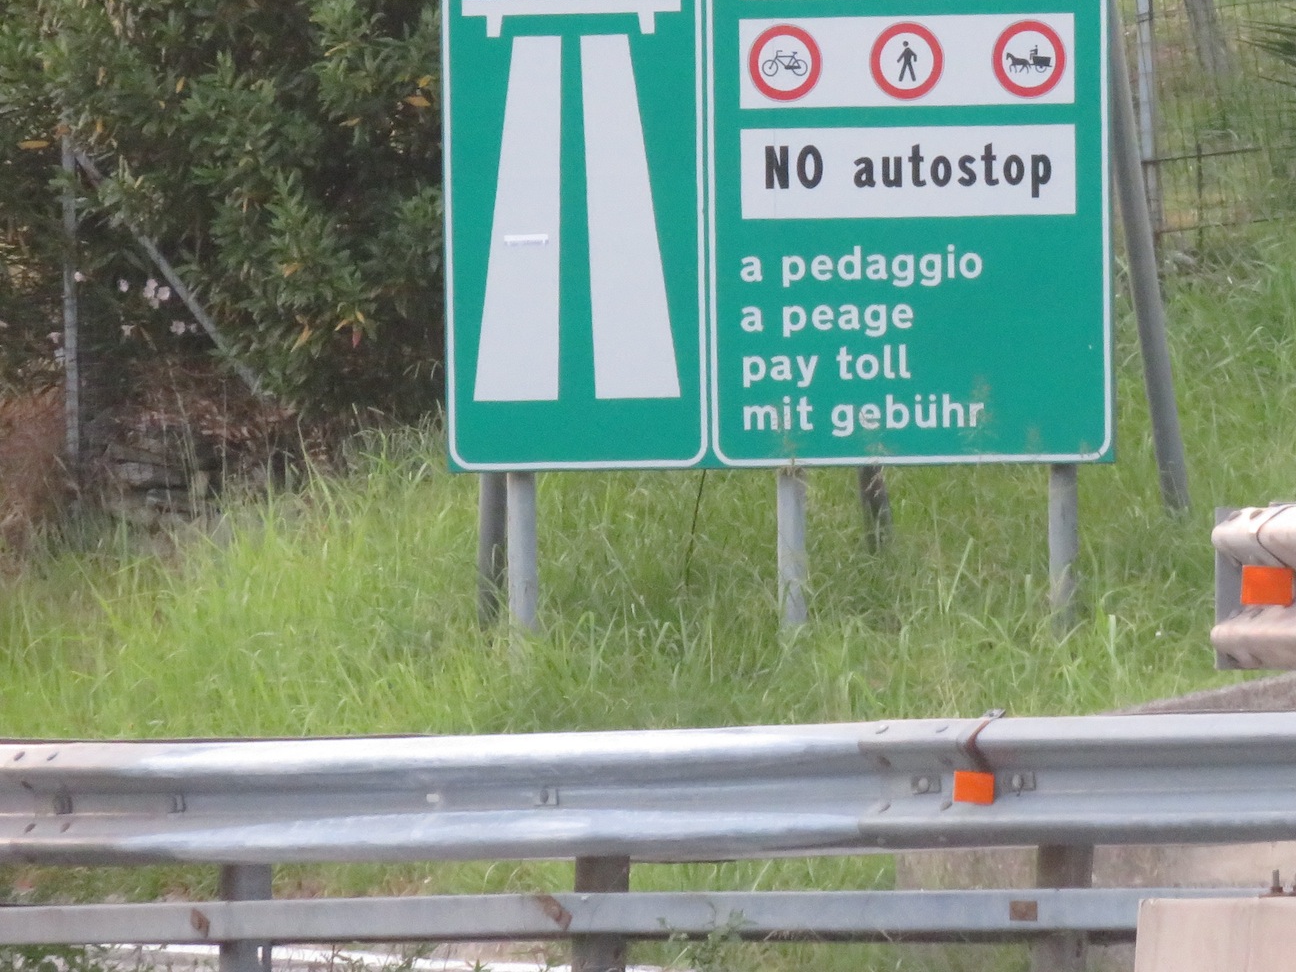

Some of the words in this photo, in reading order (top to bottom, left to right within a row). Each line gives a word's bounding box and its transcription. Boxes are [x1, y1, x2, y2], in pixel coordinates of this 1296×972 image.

[764, 144, 824, 190] NO
[853, 142, 1053, 199] autostop
[740, 255, 763, 283] a
[781, 244, 983, 288] pedaggio
[740, 305, 764, 333] a
[782, 303, 914, 338] peage
[742, 355, 819, 388] pay
[836, 343, 911, 380] toll
[743, 395, 814, 431] mit
[831, 393, 985, 438] gebühr
